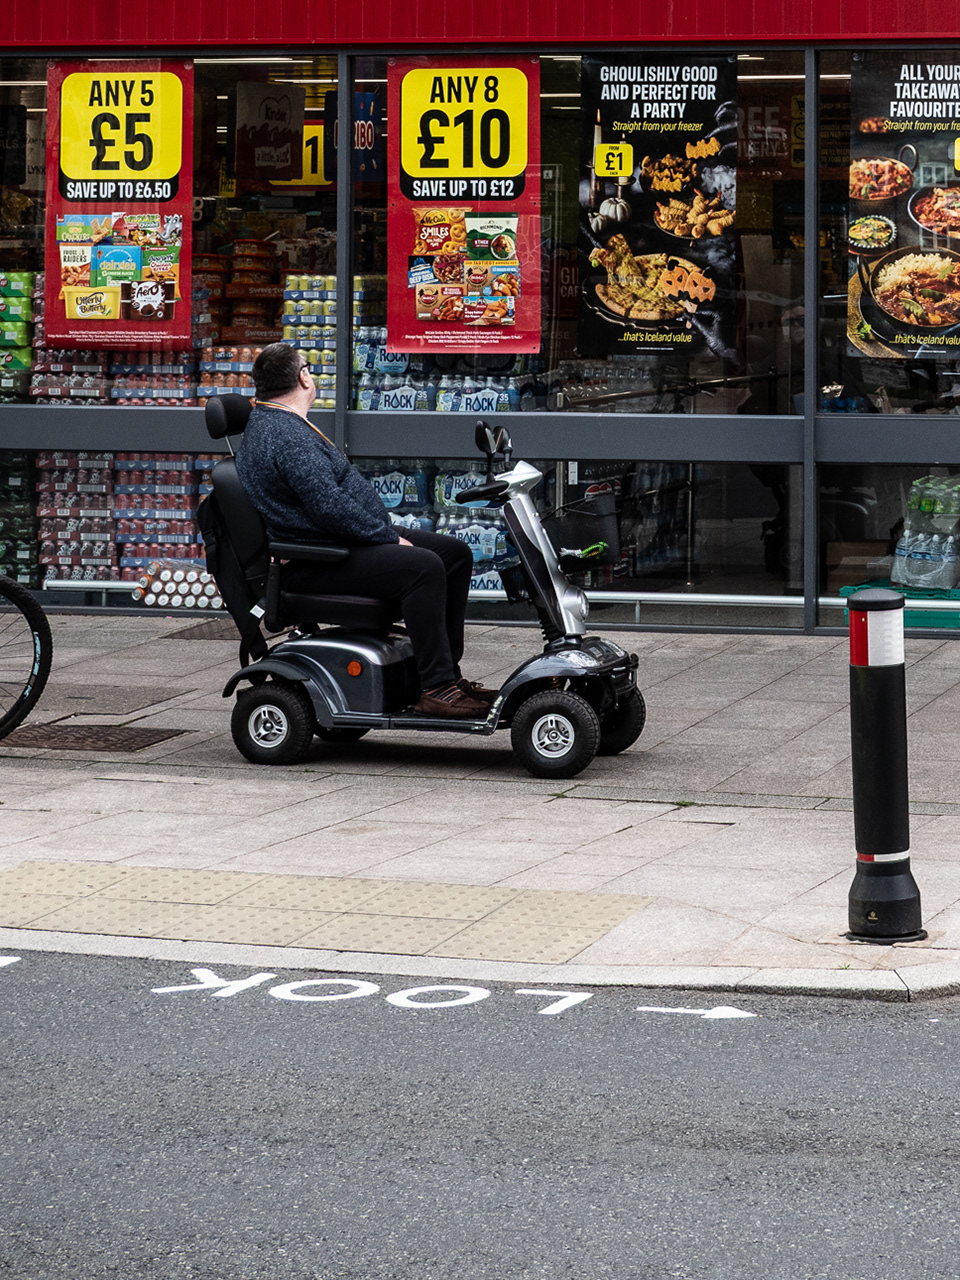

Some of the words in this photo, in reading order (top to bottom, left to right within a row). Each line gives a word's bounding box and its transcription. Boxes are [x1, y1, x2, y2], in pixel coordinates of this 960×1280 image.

[600, 66, 680, 82] GHOULISHLY
[682, 66, 718, 82] GOOD
[900, 65, 924, 80] ALL
[88, 80, 136, 107] ANY
[140, 80, 154, 107] 5
[429, 76, 479, 103] ANY
[484, 75, 499, 103] 8
[600, 84, 630, 100] AND
[632, 84, 689, 100] PERFECT
[691, 84, 716, 100] FOR
[630, 103, 641, 118] A
[643, 103, 686, 118] PARTY
[612, 121, 641, 133] Straight
[642, 121, 659, 131] from
[660, 122, 678, 133] your
[678, 122, 704, 132] freezer
[89, 112, 154, 171] £5
[417, 108, 510, 169] £10
[604, 152, 623, 171] £1
[66, 182, 98, 199] SAVE
[99, 182, 116, 199] UP
[117, 182, 134, 198] TO
[135, 182, 171, 199] £6.50
[413, 180, 446, 197] SAVE
[450, 180, 468, 197] UP
[470, 180, 487, 196] TO
[490, 179, 514, 196] £12
[425, 215, 446, 224] McCain
[420, 227, 449, 239] SMILES
[99, 260, 136, 271] dairylea
[75, 293, 103, 306] Utterly
[79, 304, 106, 314] Butterly
[645, 332, 673, 342] Iceland
[673, 332, 692, 342] value
[384, 393, 413, 408] ROCK
[417, 390, 428, 398] 35
[498, 393, 509, 402] 35
[465, 397, 494, 412] ROCK
[150, 967, 595, 1016] LOOK
